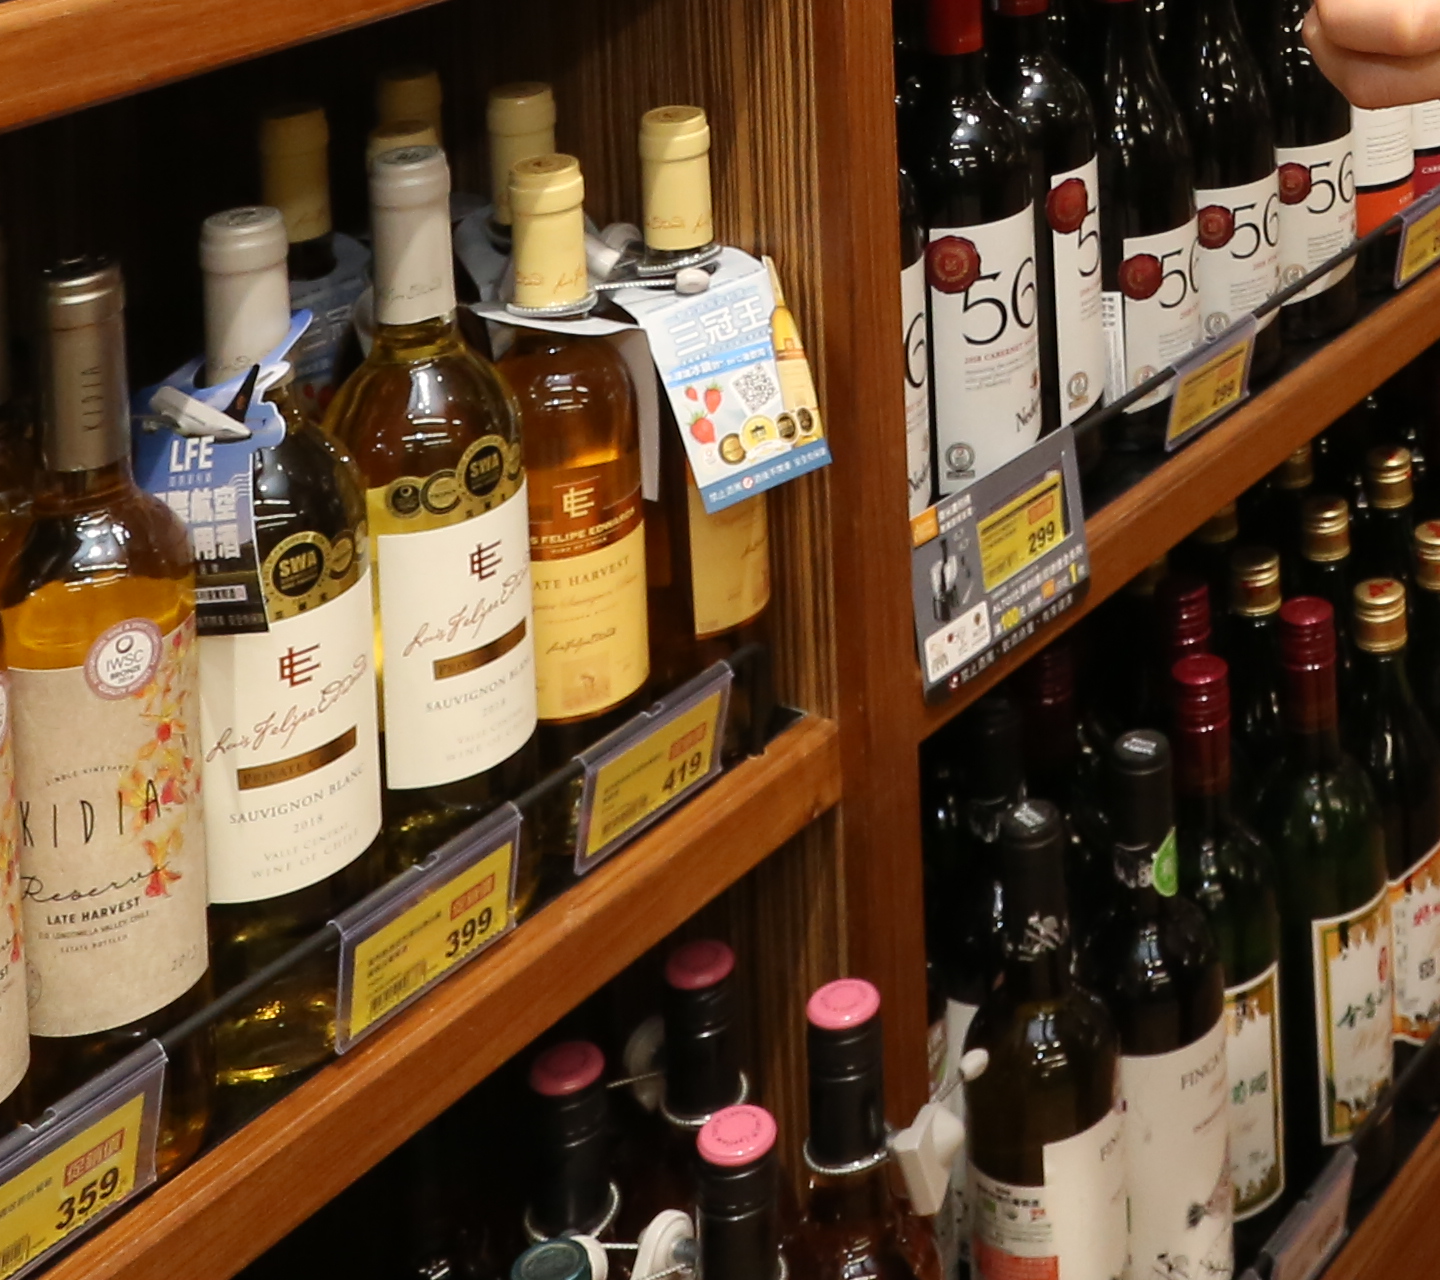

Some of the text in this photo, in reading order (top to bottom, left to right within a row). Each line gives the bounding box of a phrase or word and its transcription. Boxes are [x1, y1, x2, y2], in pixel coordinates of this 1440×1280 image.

[1306, 151, 1354, 215] 56
[962, 257, 1037, 345] 56
[669, 296, 770, 357] 三冠王
[168, 435, 215, 472] LFE
[470, 450, 500, 479] SWA
[540, 528, 586, 544] FELIPE
[1027, 520, 1055, 557] 299
[277, 549, 318, 578] SWA
[568, 556, 630, 588] HARVEST
[105, 649, 143, 674] IWSC
[426, 677, 506, 712] SAUVIGNON
[661, 751, 701, 792] 419
[19, 778, 161, 849] KIDIA
[229, 790, 324, 824] SAUVIGNON
[293, 813, 324, 834] 2018
[252, 863, 291, 880] WINE
[46, 897, 141, 926] LATE HARVEST
[445, 906, 492, 959] 399
[55, 1166, 119, 1232] 359
